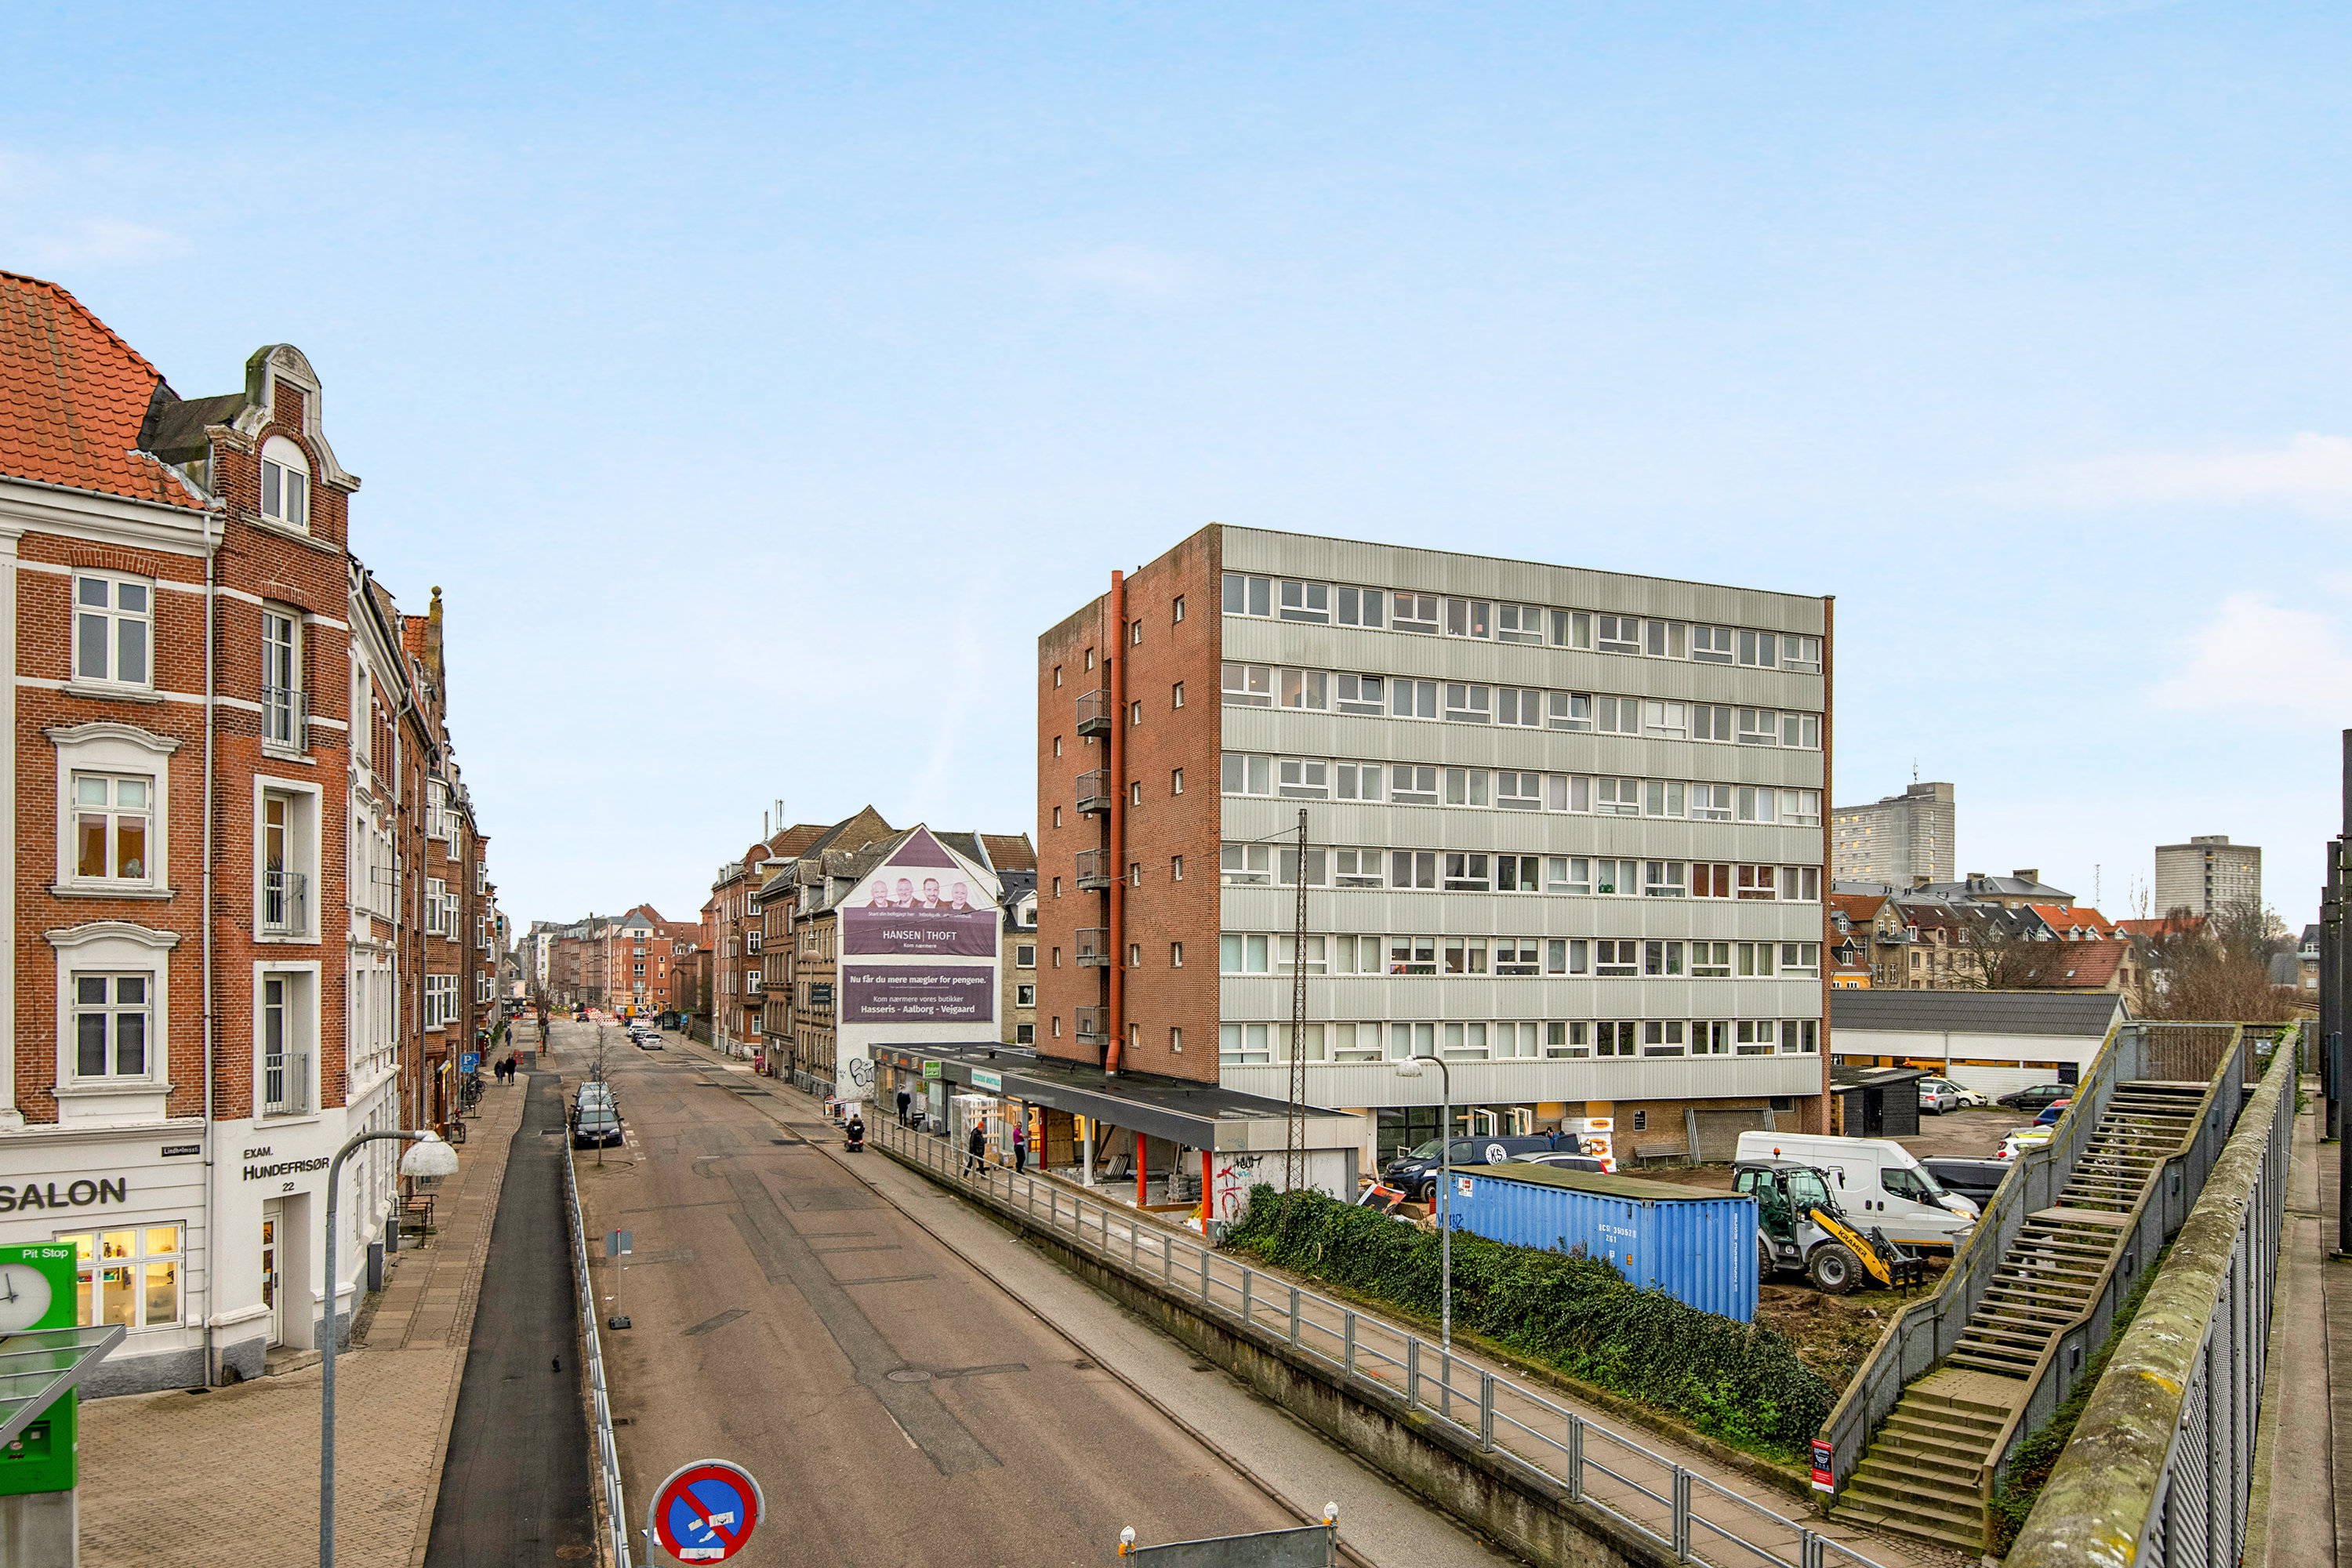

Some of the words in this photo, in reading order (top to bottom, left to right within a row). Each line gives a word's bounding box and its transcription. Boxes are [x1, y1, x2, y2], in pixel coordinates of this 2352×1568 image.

[883, 930, 921, 940] HANSEN
[926, 931, 957, 941] THOFT
[862, 975, 873, 984] får
[876, 975, 886, 984] du
[909, 976, 938, 985] mægler
[939, 975, 951, 984] for
[861, 1004, 896, 1014] Hasseris
[902, 1004, 935, 1015] Aalborg
[941, 1004, 975, 1014] Vejgaard
[463, 1055, 472, 1065] P
[243, 1146, 274, 1160] EXAM.
[243, 1156, 330, 1181] HUNDEFRISØR
[282, 1181, 295, 1192] 22
[0, 1177, 126, 1212] SALON
[1838, 1230, 1867, 1258] KRAMER
[23, 1249, 38, 1259] Pit
[42, 1248, 68, 1259] Stop
